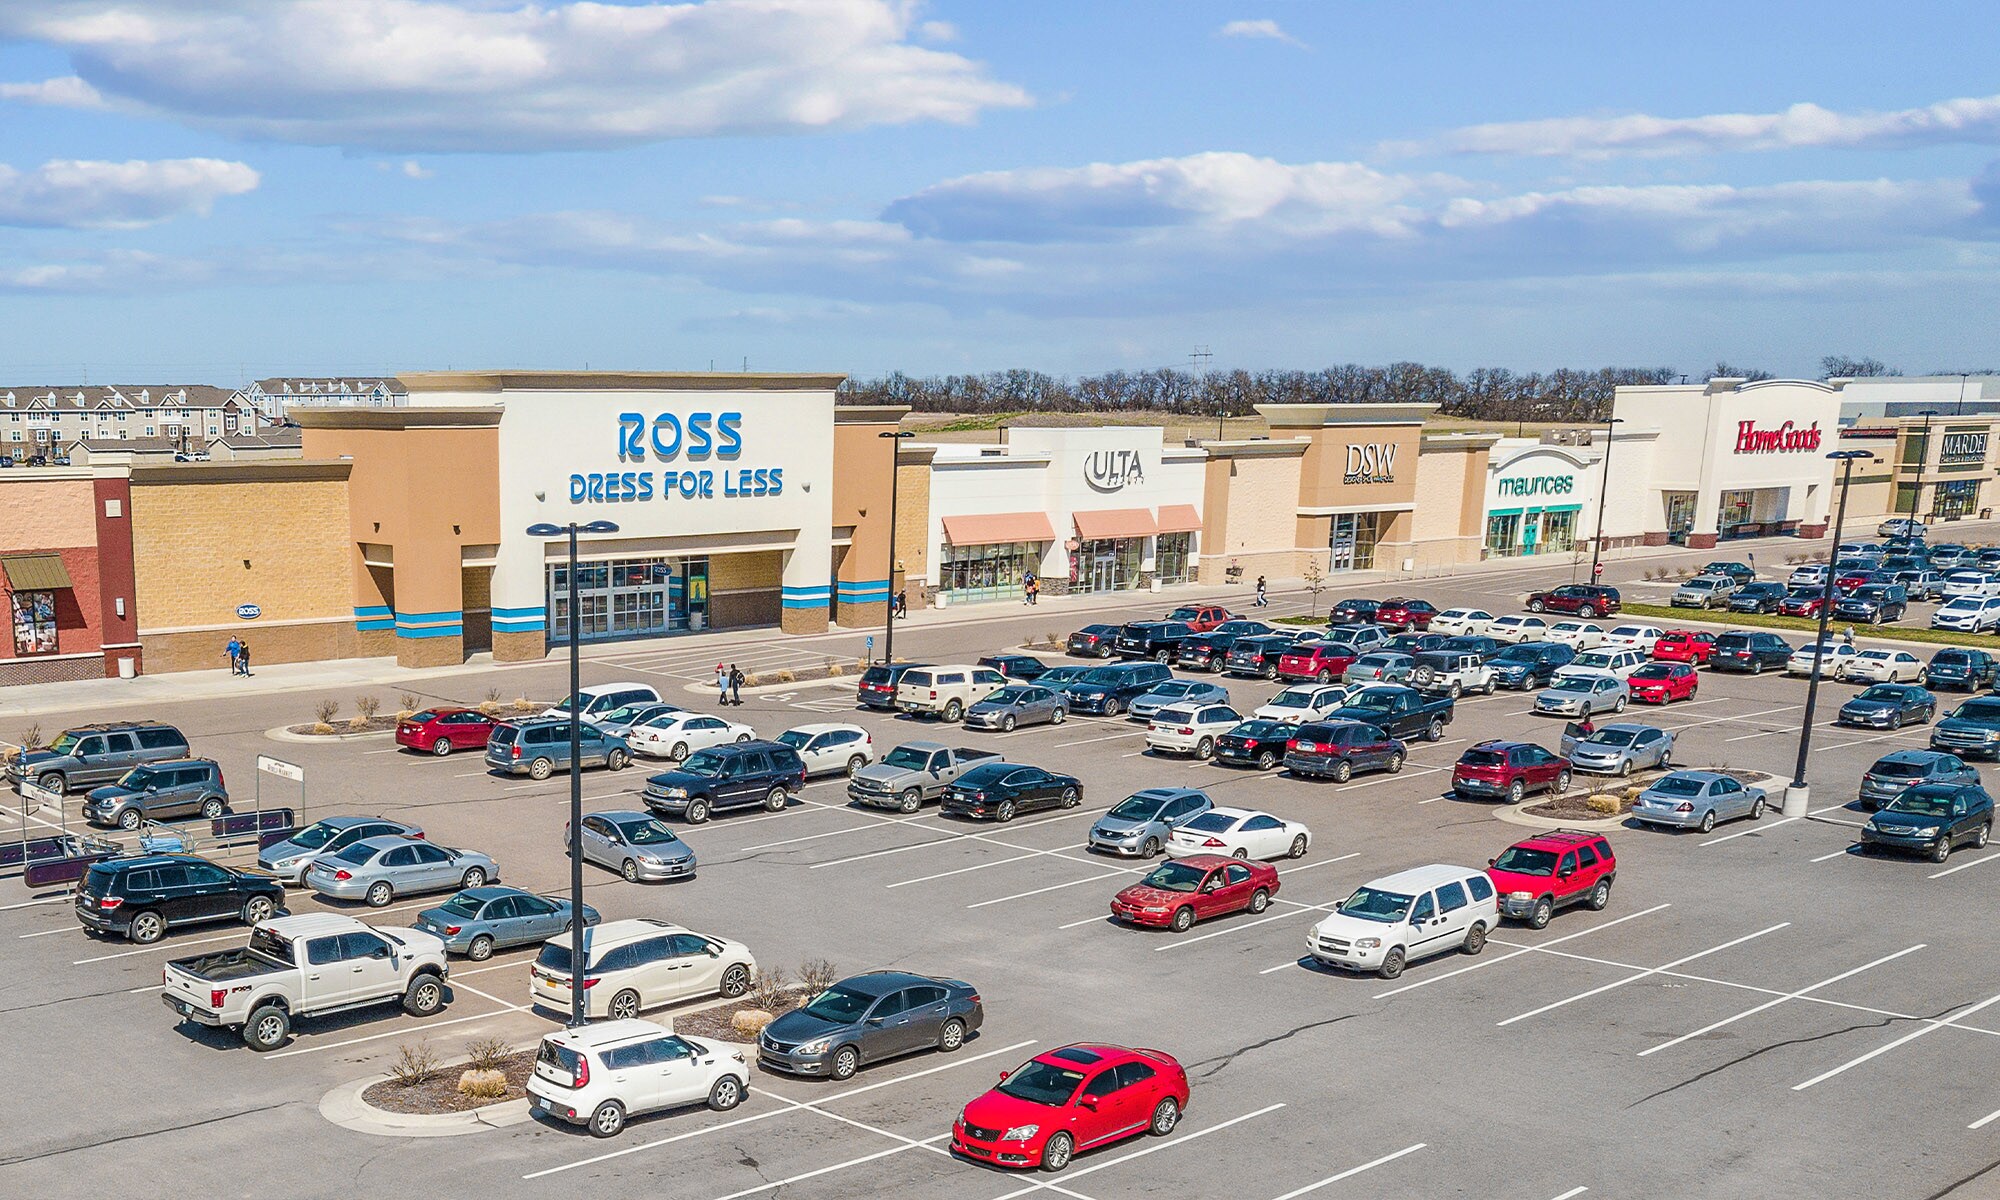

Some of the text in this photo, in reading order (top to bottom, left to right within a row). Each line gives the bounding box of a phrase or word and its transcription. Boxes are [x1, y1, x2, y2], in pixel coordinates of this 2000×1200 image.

[617, 411, 743, 458] ROSS
[1734, 420, 1822, 454] HomeGoods
[1942, 433, 1988, 455] MARDEL
[1093, 450, 1143, 480] ULTA
[1345, 443, 1399, 477] DSW
[567, 467, 784, 503] DRESS FOR LESS
[1498, 474, 1574, 497] maurices
[238, 607, 259, 615] ROSS
